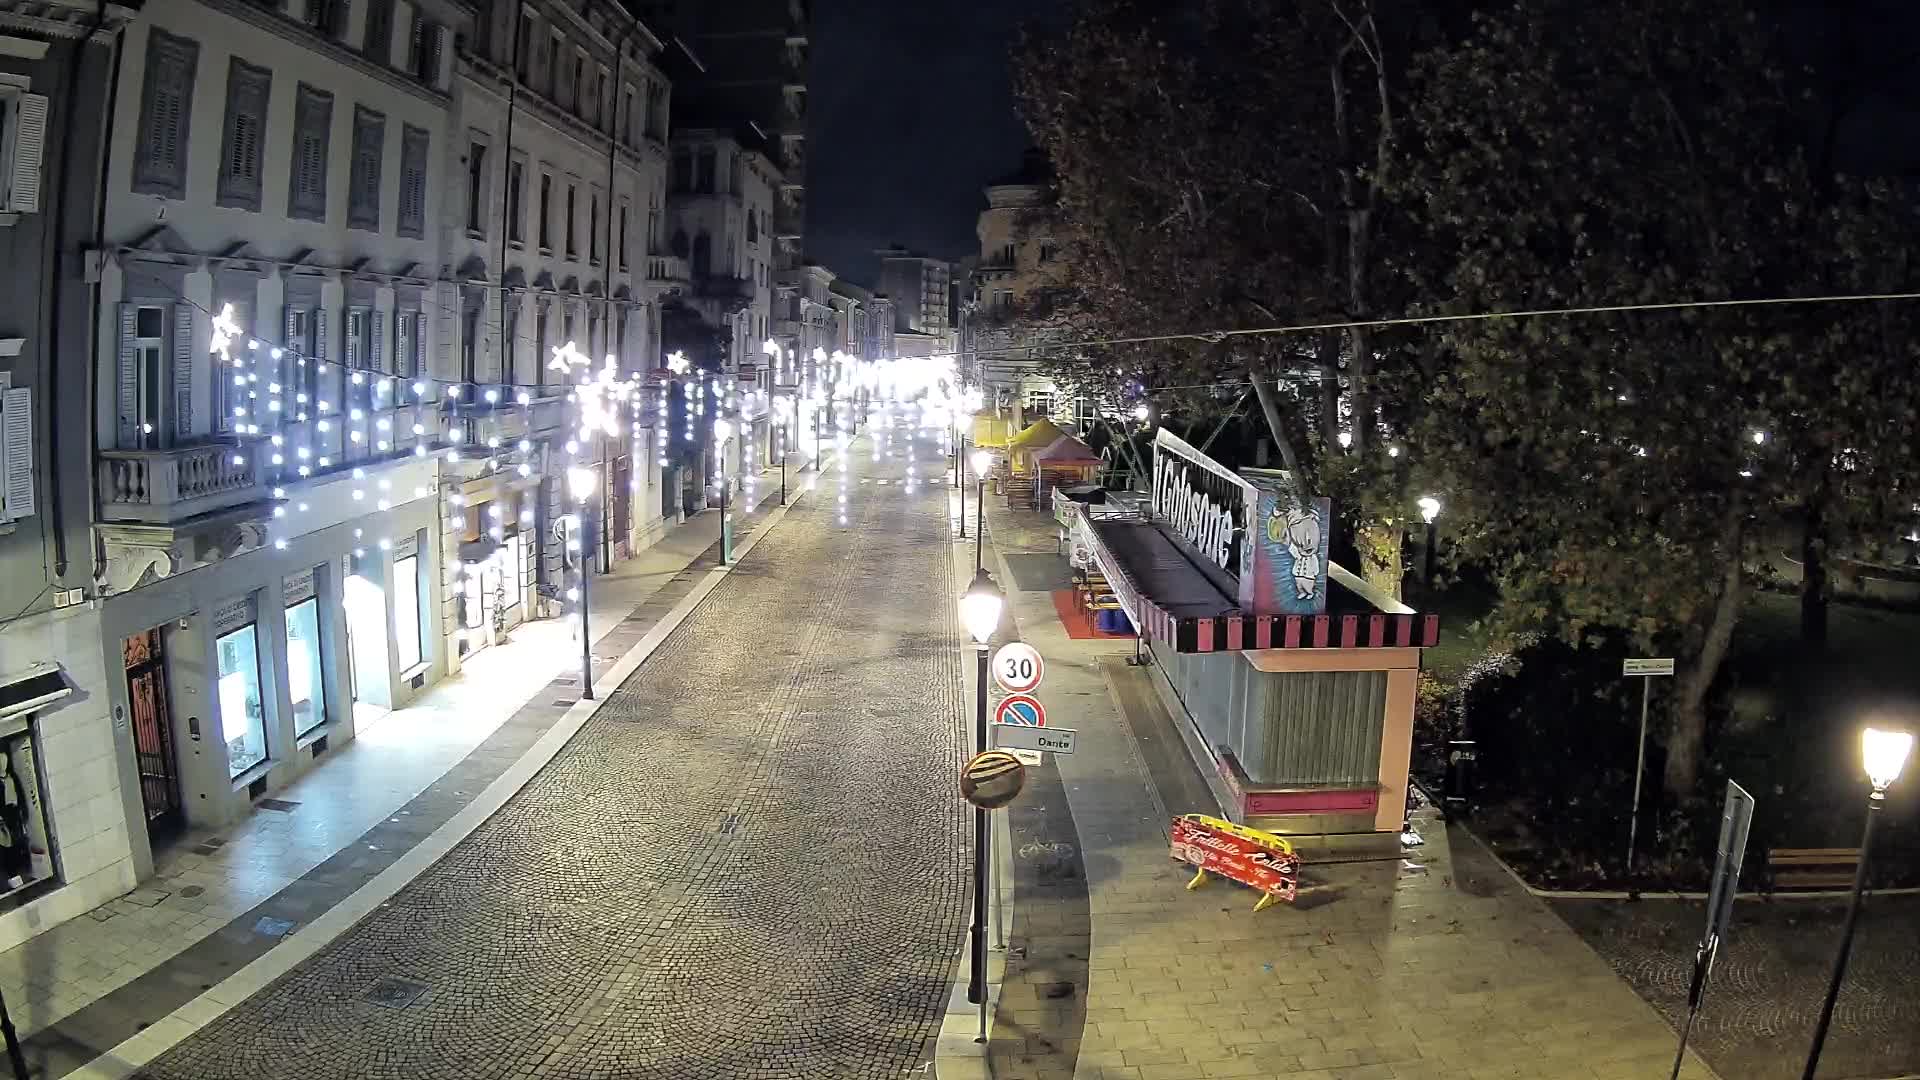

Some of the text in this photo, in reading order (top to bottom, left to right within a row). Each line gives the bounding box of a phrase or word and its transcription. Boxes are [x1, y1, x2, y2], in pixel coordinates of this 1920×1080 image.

[1162, 458, 1233, 569] Golosone
[1006, 658, 1032, 679] 30
[1038, 737, 1070, 749] Dante
